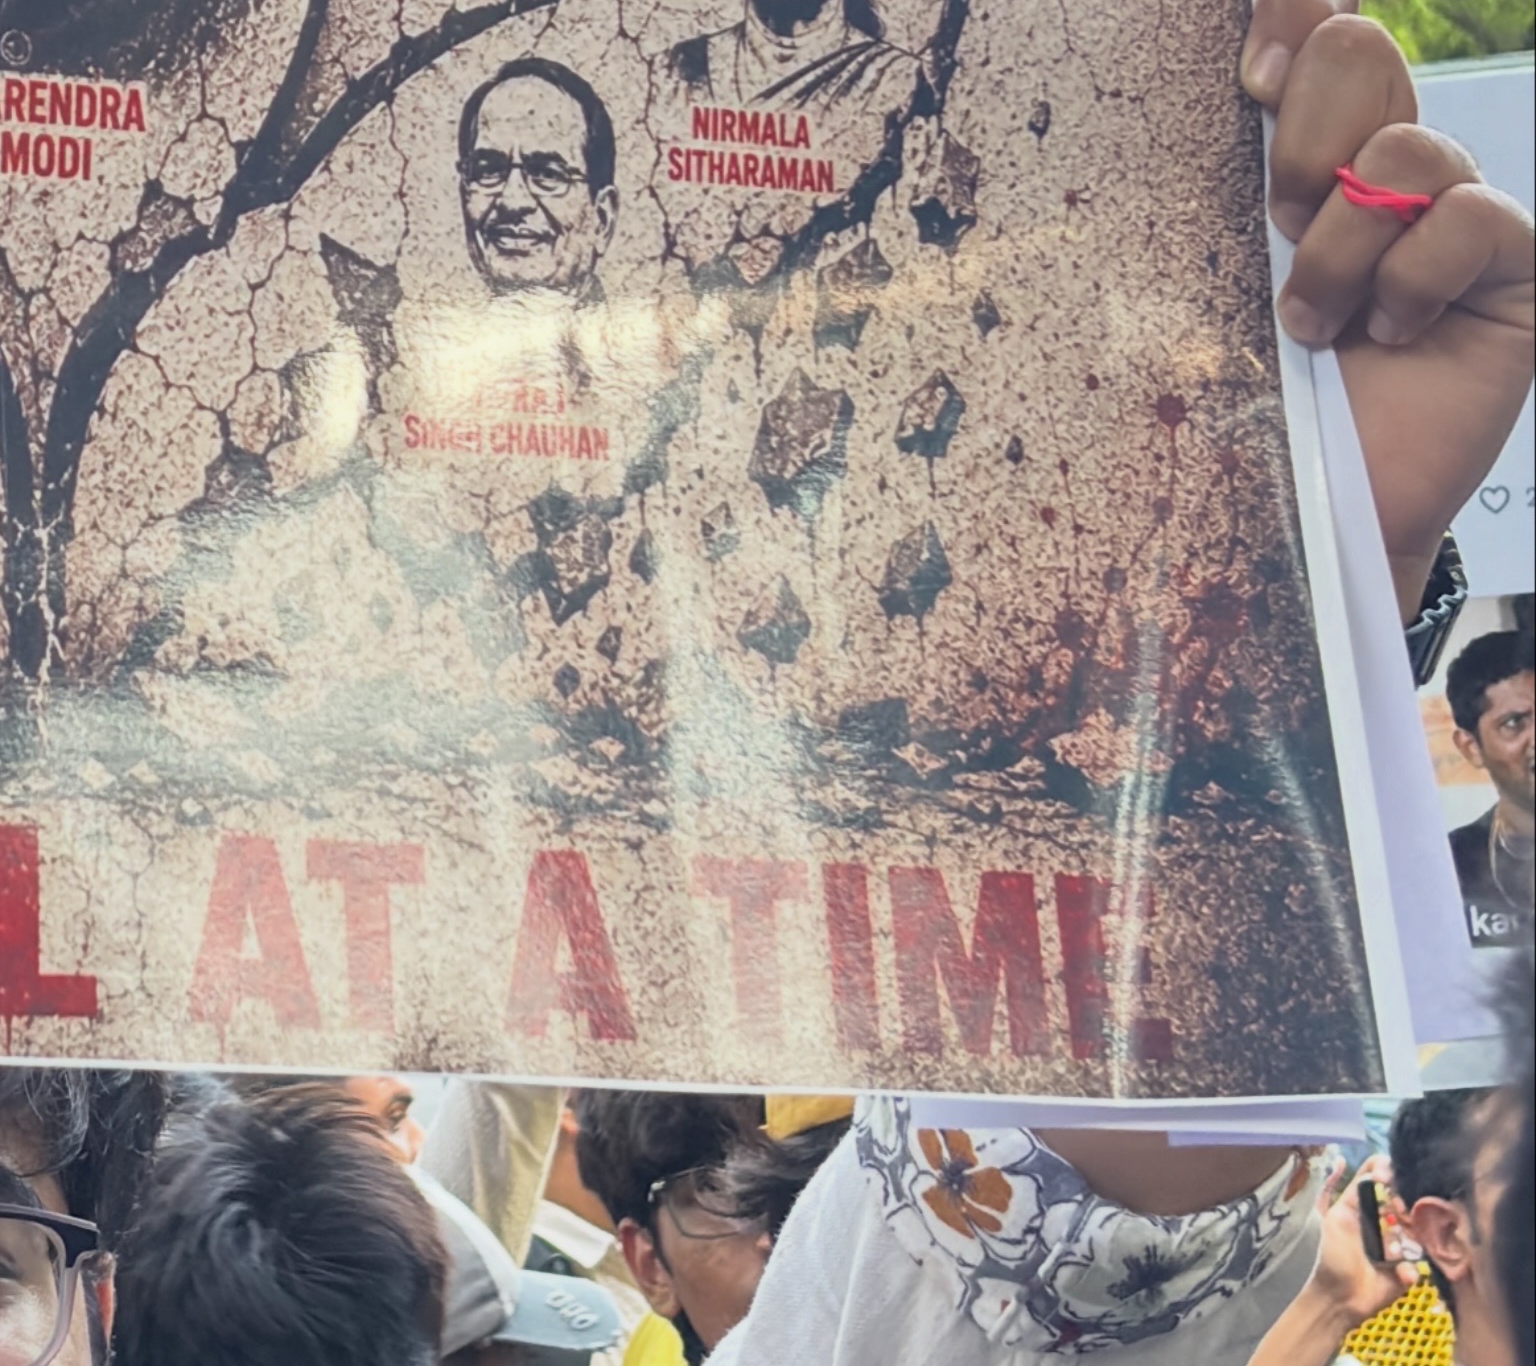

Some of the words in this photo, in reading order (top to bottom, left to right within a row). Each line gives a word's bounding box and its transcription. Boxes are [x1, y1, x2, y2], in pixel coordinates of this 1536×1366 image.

[691, 106, 811, 149] NIRMALA
[0, 130, 92, 181] MODI
[667, 146, 835, 194] SITHARAMAN
[489, 420, 610, 461] CHAUHAN
[185, 834, 425, 1037] AT
[503, 849, 638, 1043] A
[690, 855, 1173, 1062] TIME
